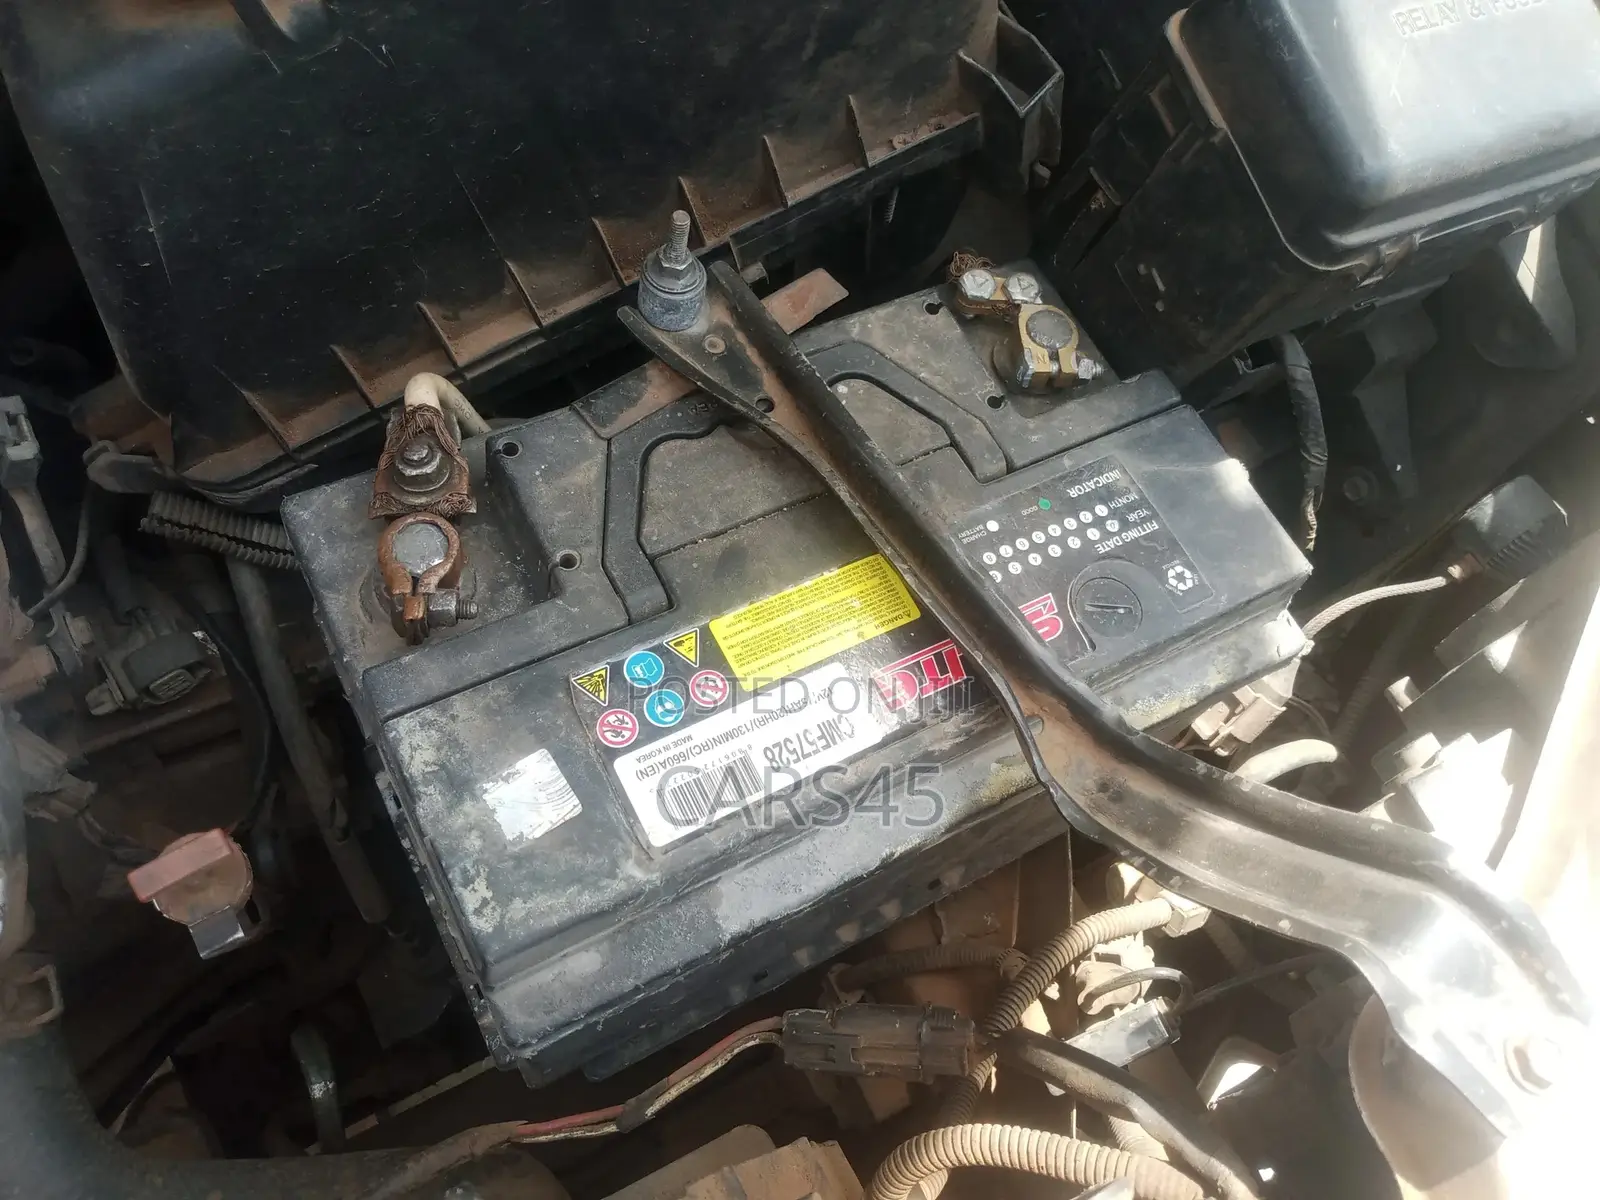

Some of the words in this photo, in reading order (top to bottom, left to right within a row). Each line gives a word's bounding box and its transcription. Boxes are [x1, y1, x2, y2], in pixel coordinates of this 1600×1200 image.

[1392, 0, 1461, 36] RELAY
[1066, 469, 1122, 498] INDICATOR
[1108, 491, 1139, 510] MONTH
[1126, 508, 1152, 523] YEAR
[958, 524, 984, 539] BATTERY
[961, 530, 987, 544] CHARGE
[1120, 520, 1159, 543] FITTING
[1094, 535, 1122, 554] DATE
[663, 744, 671, 752] IN
[672, 734, 693, 748] MADE
[763, 714, 855, 772] CMF57528
[636, 748, 663, 764] KOREA
